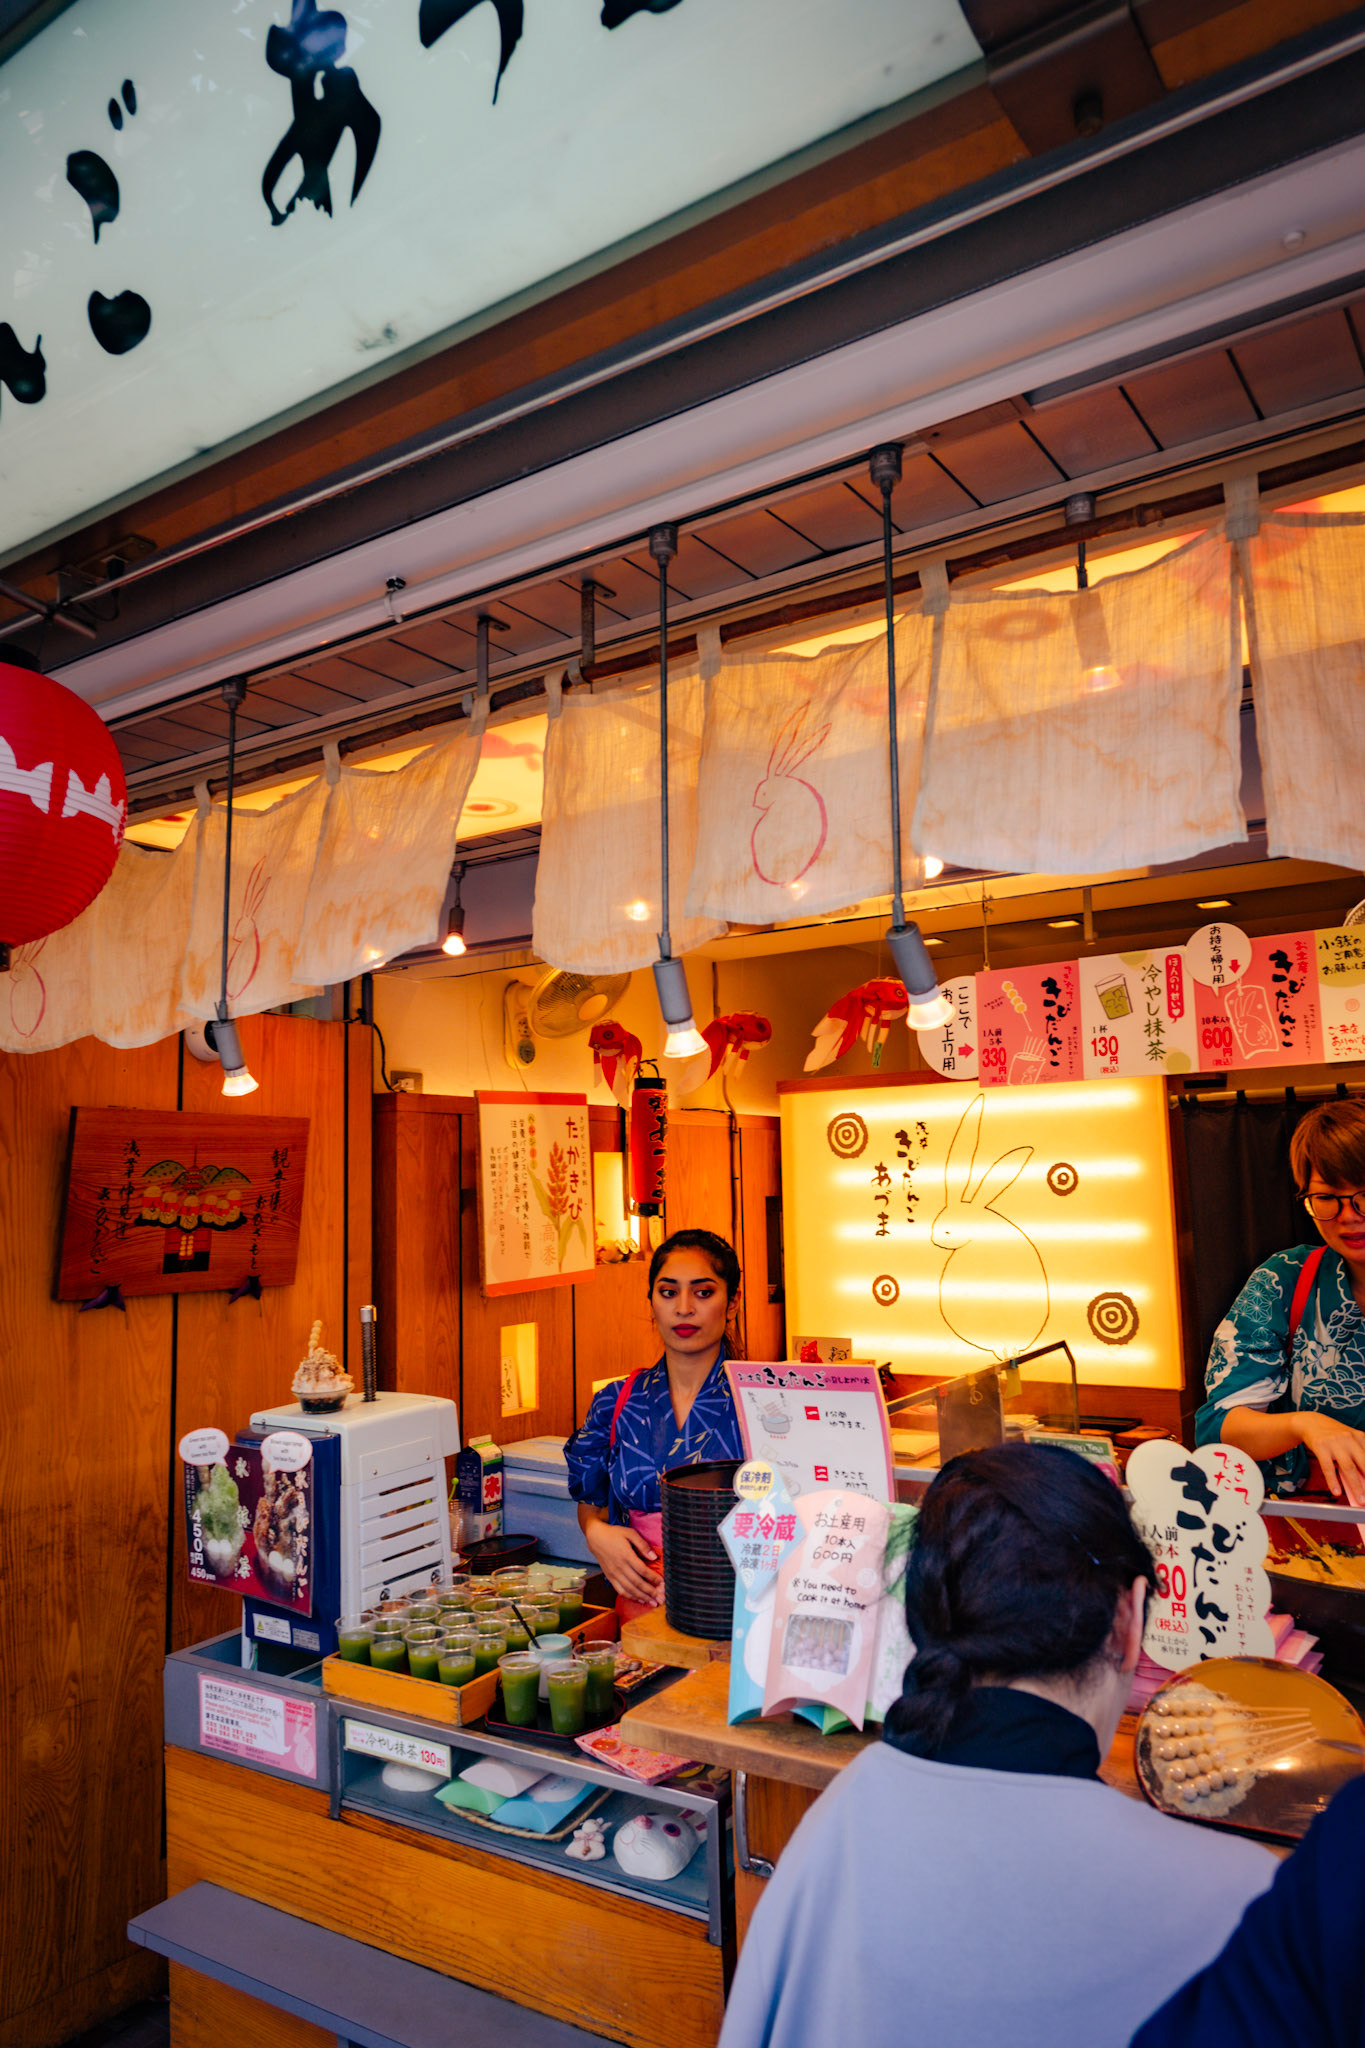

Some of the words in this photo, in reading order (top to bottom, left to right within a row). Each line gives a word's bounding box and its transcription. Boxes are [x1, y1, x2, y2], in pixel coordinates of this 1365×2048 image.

[1208, 925, 1226, 985] お持ち帰り用
[958, 985, 973, 1029] ここで
[1269, 949, 1307, 1048] きびだんご
[1041, 976, 1073, 1066] きびだんご
[1141, 963, 1167, 1062] 冷やし抹茶
[983, 1028, 1003, 1038] 1人前
[1202, 1026, 1233, 1050] 600
[982, 1046, 1008, 1068] 330
[1091, 1035, 1119, 1057] 130
[1222, 1048, 1234, 1058] 円
[997, 1065, 1008, 1076] 円
[1109, 1055, 1119, 1066] 円
[565, 1116, 584, 1221] たかきび
[894, 1129, 921, 1223] きびだんご
[870, 1161, 893, 1237] あづま
[740, 1470, 773, 1484] 保冷剤
[732, 1512, 797, 1542] 要冷蔵
[814, 1512, 867, 1533] お土産用
[192, 1509, 203, 1565] 450円
[825, 1534, 856, 1550] 10本入
[741, 1542, 781, 1557] 冷蔵2日
[812, 1546, 853, 1563] 600円
[1170, 1460, 1246, 1661] きびだんご
[803, 1578, 817, 1590] You
[821, 1583, 843, 1592] need
[845, 1586, 857, 1595] to
[820, 1595, 828, 1603] it
[1171, 1602, 1188, 1619] 円
[1154, 1616, 1190, 1635] (税込)
[365, 1731, 418, 1760] 冷やし抹茶
[420, 1749, 437, 1765] 130
